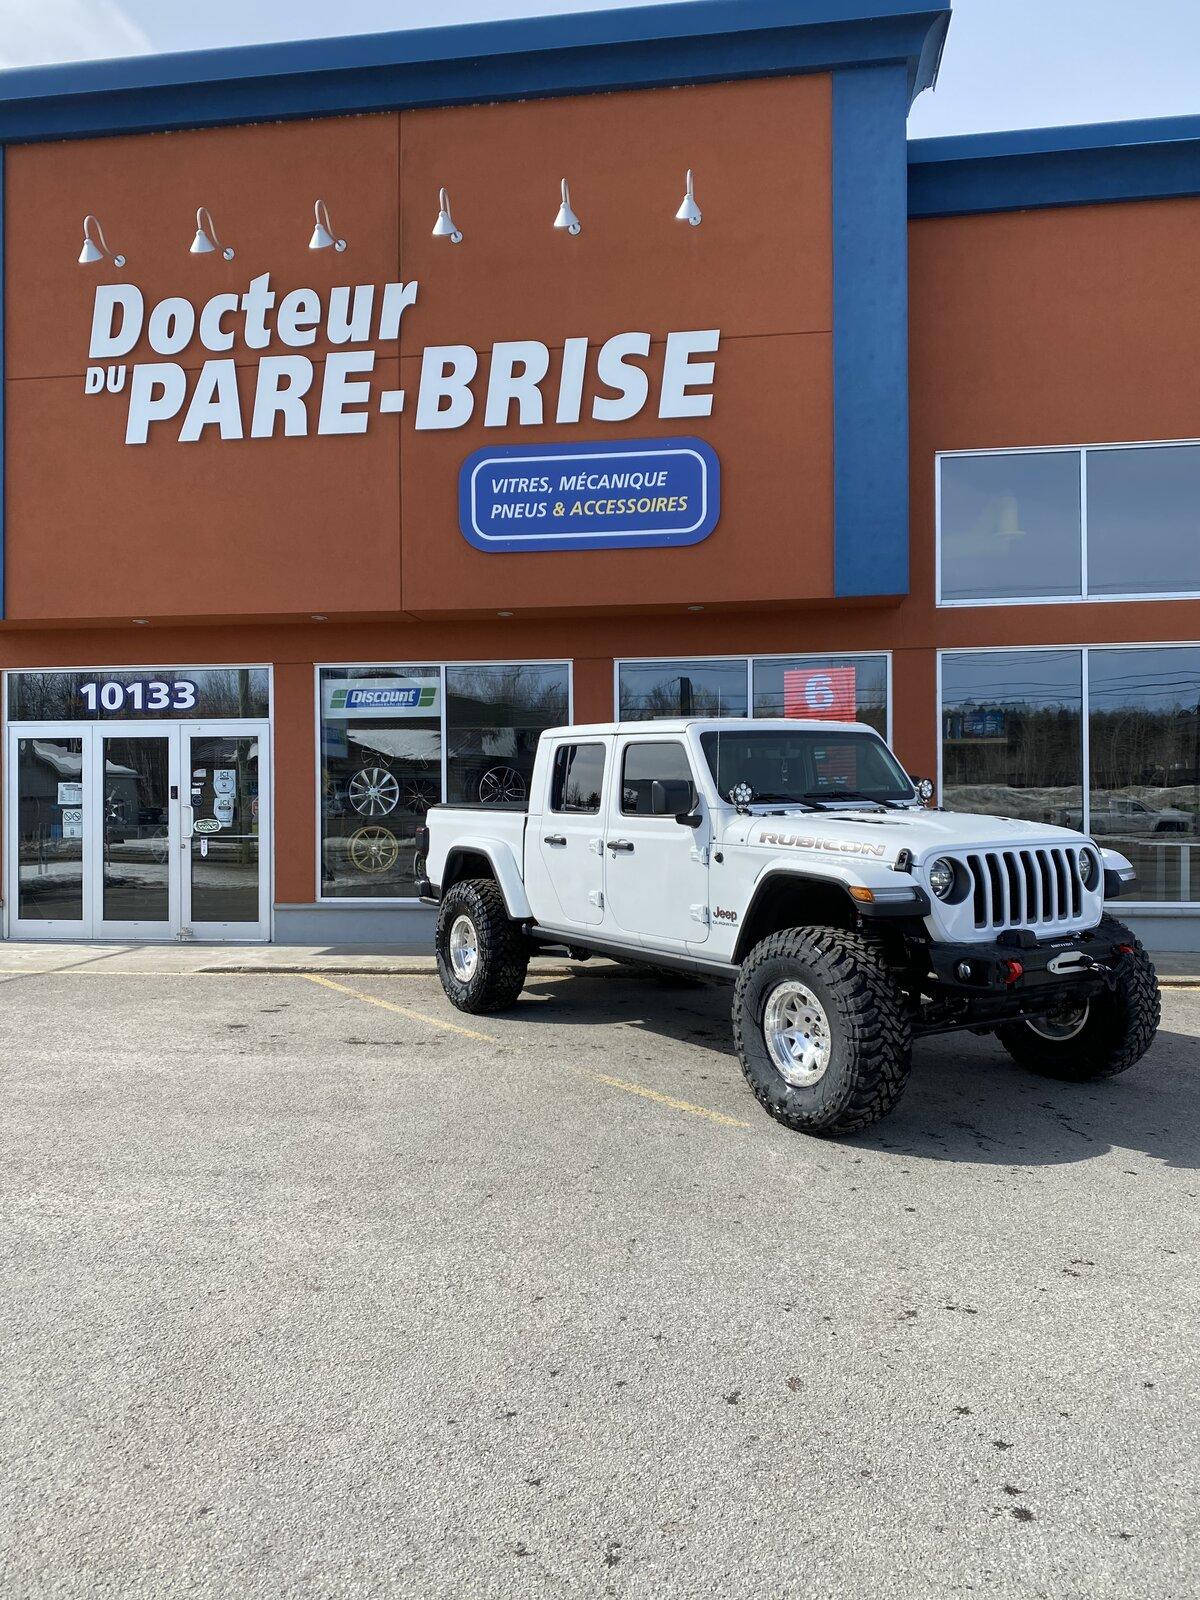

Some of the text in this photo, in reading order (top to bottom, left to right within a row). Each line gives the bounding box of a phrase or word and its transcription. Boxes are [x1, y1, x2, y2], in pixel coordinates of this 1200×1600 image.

[88, 272, 418, 359] Docteur
[84, 329, 721, 445] DU PARE-BRISE
[491, 471, 668, 494] VITRES, MÉCANIQUE
[491, 496, 689, 519] PNEUS & ACCESSOIRES
[79, 681, 196, 710] 10133
[350, 689, 416, 703] Discount
[805, 674, 834, 709] 6
[759, 832, 887, 857] RUBICON
[712, 906, 738, 922] Jeep
